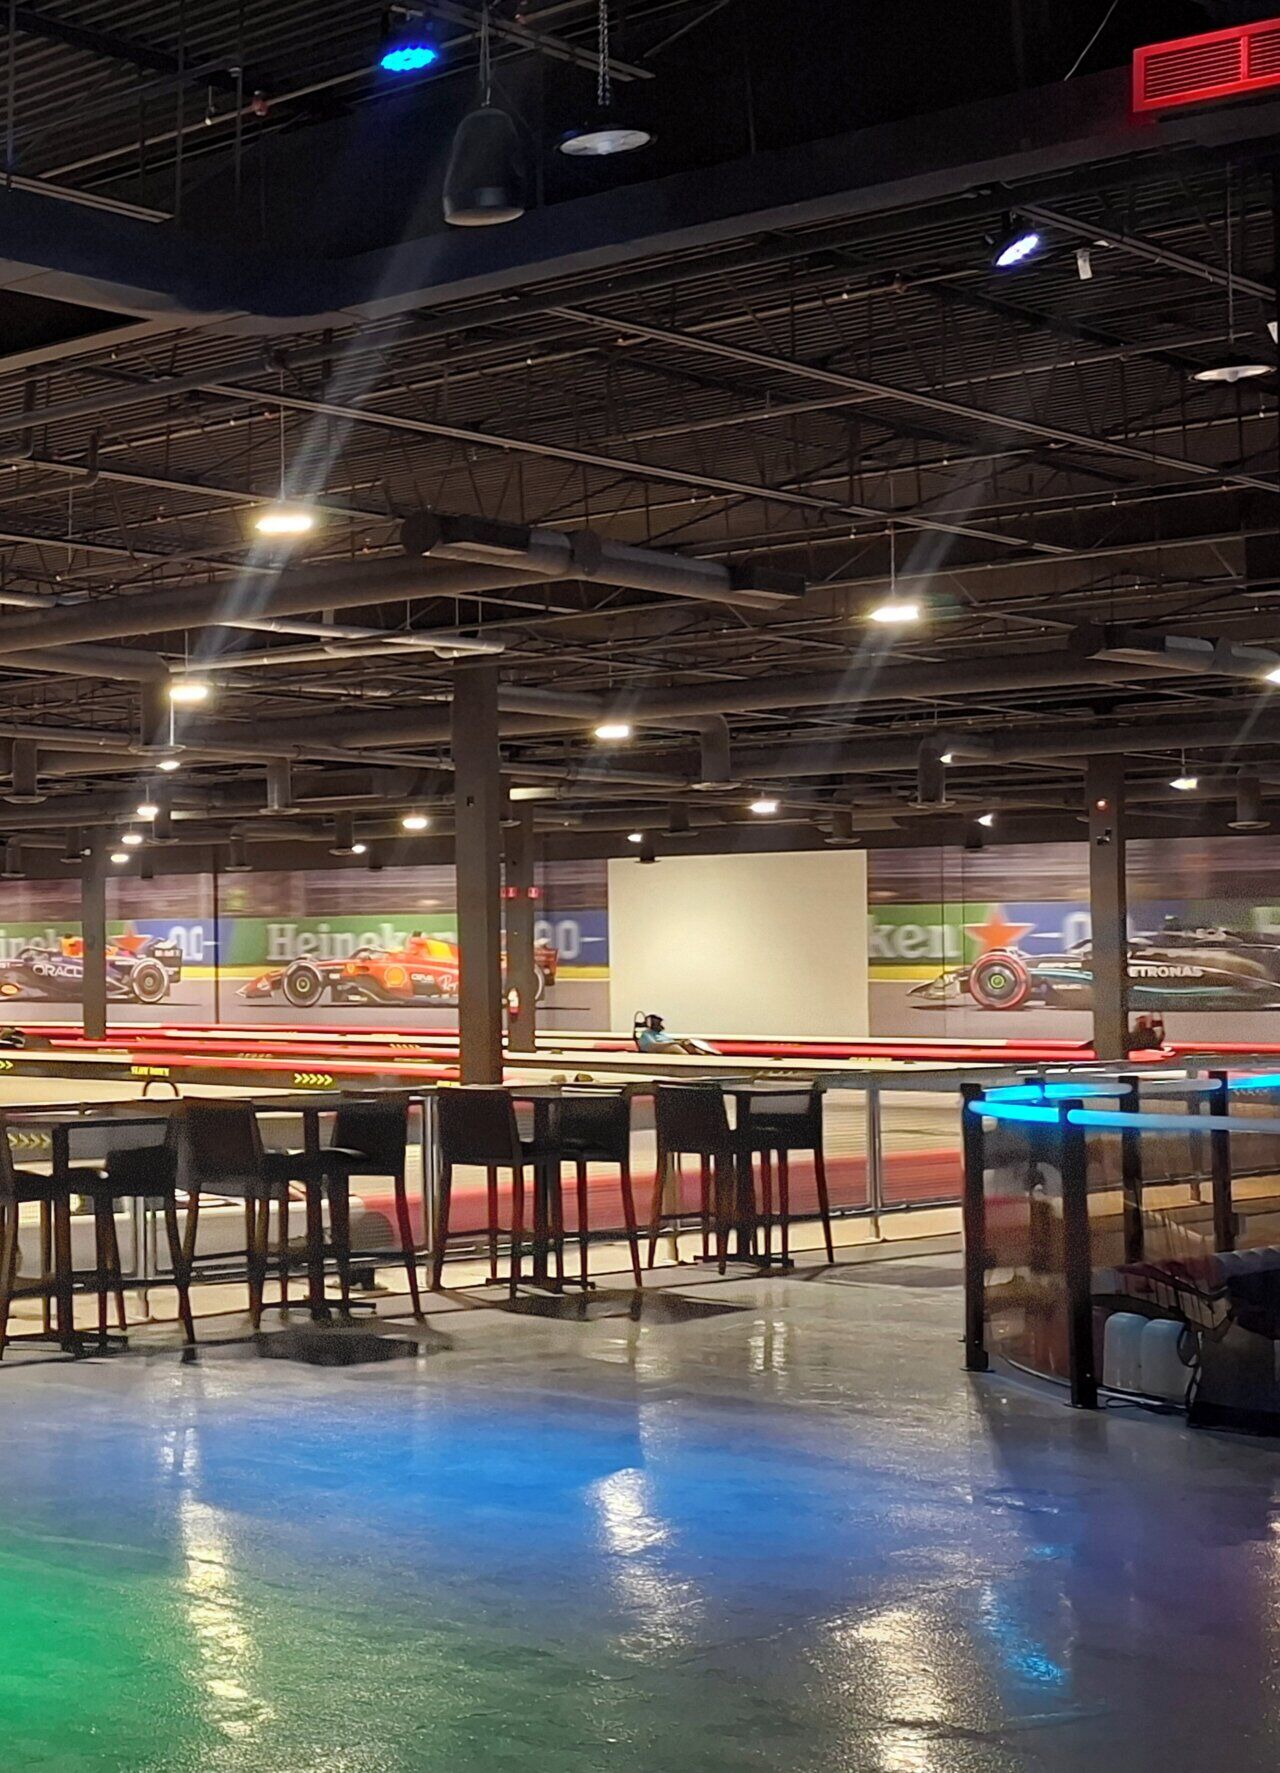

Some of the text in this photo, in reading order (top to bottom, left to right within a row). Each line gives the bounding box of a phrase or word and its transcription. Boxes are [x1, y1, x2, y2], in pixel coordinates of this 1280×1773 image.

[868, 914, 961, 959] ken
[32, 964, 84, 978] ORACL
[1127, 966, 1203, 978] ETRONAS
